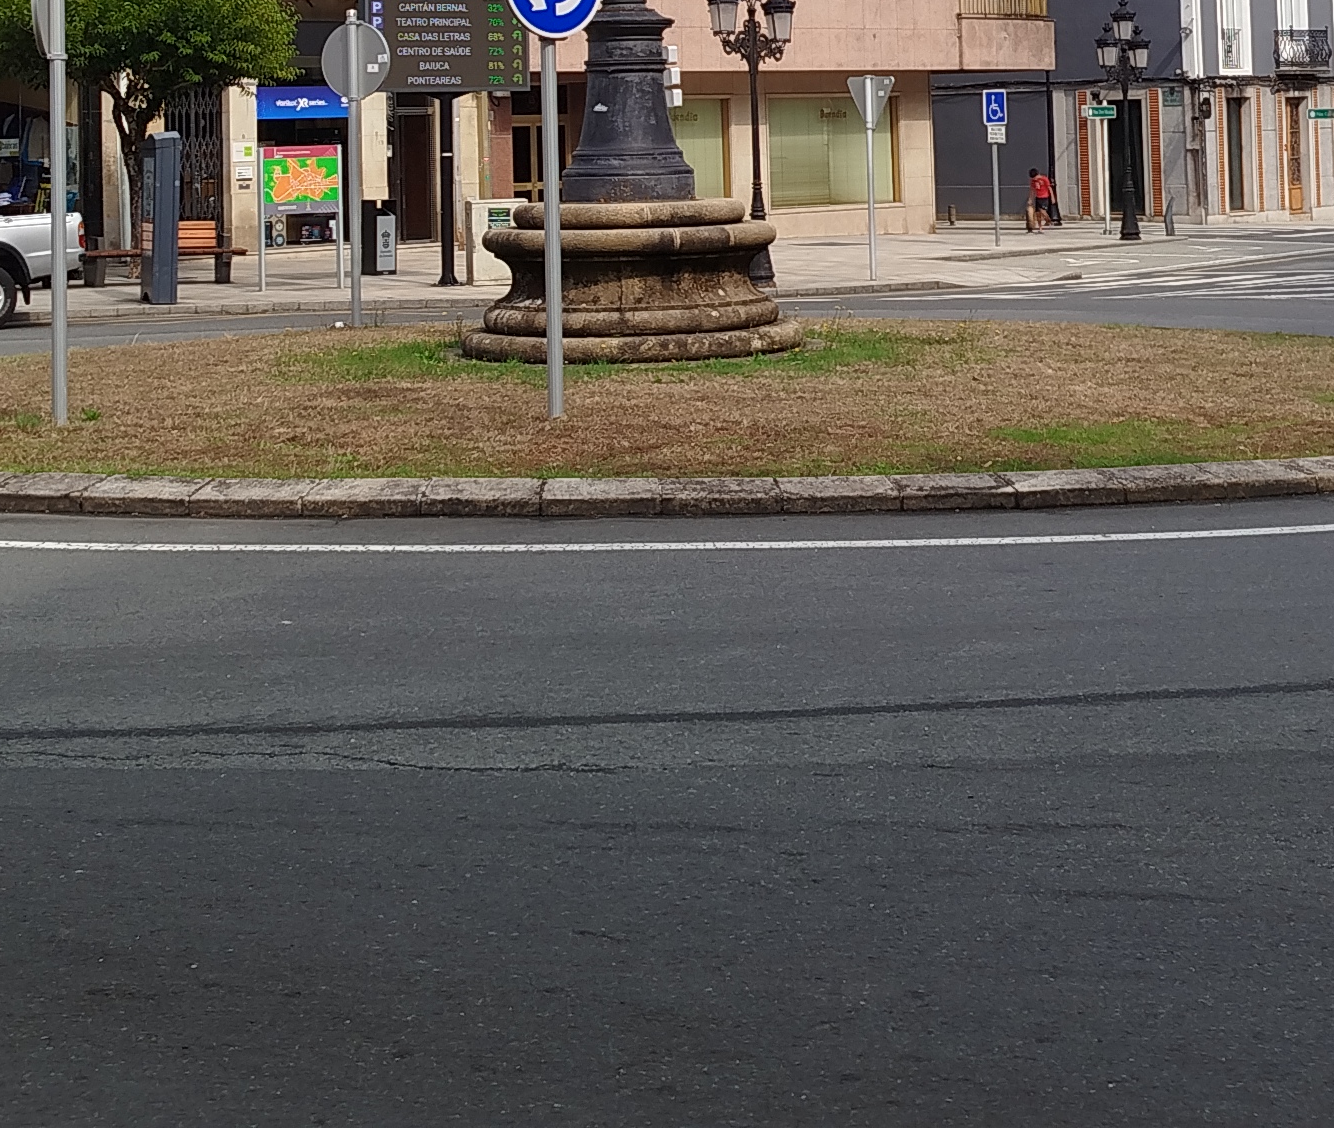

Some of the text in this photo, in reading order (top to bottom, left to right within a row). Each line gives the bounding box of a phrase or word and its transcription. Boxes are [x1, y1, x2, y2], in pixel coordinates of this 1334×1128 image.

[399, 2, 468, 12] CAPITÁN BERNAL
[488, 4, 504, 12] 32%
[396, 18, 472, 26] TEATRO PRINCIPAL
[422, 33, 438, 41] DAS
[440, 33, 471, 41] LETRAS
[397, 45, 471, 55] CENTRO DE SAÚDE
[488, 47, 504, 56] 72%
[419, 62, 449, 70] BAIUCA
[488, 61, 504, 70] 81%
[407, 76, 462, 84] PONTEAREAS
[488, 76, 504, 84] 72%
